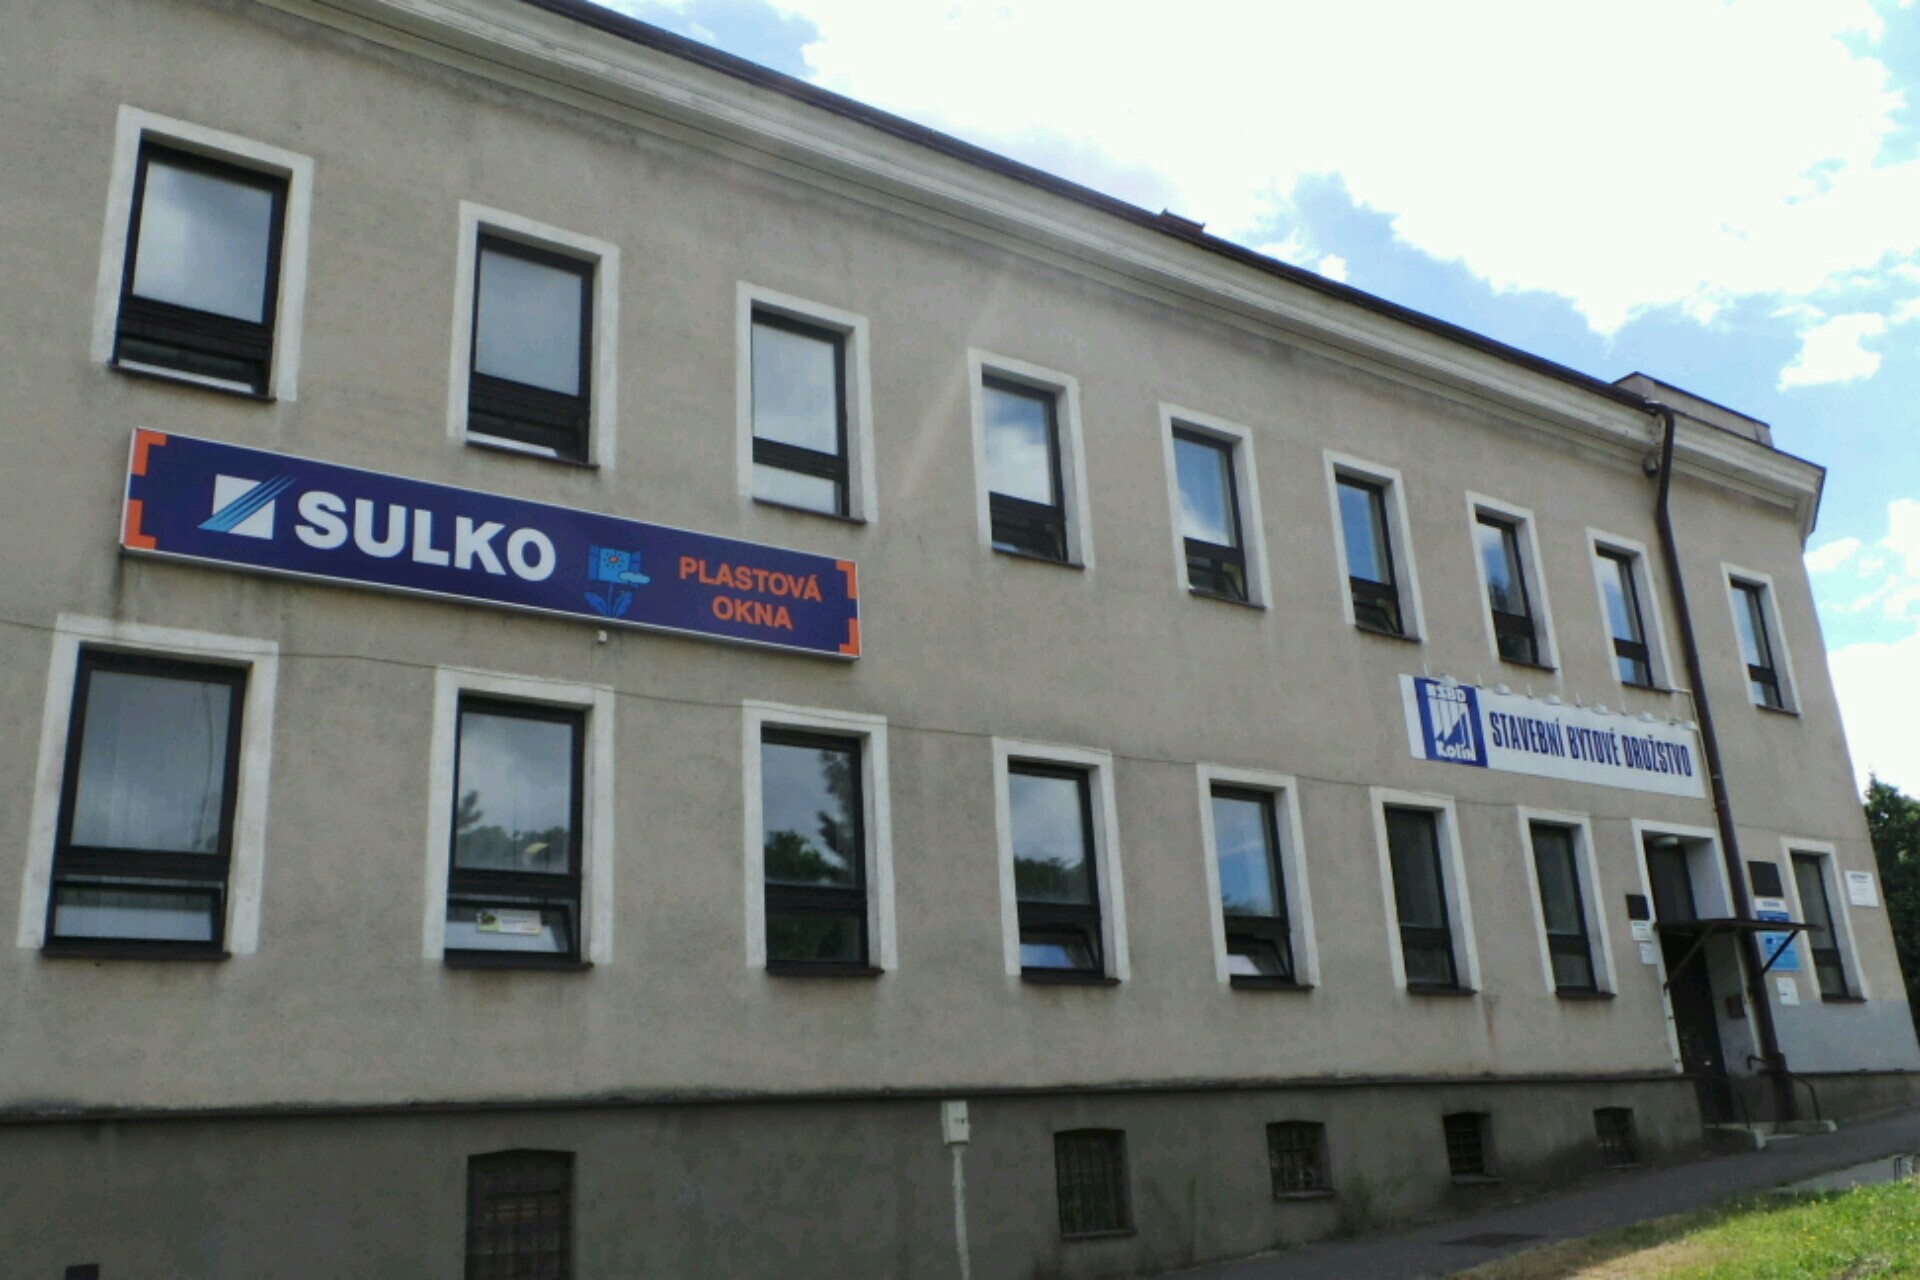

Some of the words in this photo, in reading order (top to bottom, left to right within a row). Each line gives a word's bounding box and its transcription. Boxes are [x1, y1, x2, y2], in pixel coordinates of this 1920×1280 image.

[295, 491, 556, 581] SULKO
[679, 556, 822, 602] PLASTOVÁ
[712, 596, 793, 631] OKNA
[1489, 711, 1565, 758] STAVEBNÍ
[1566, 726, 1621, 767] BYTOVÉ
[1621, 733, 1692, 778] DRUŽSTVO
